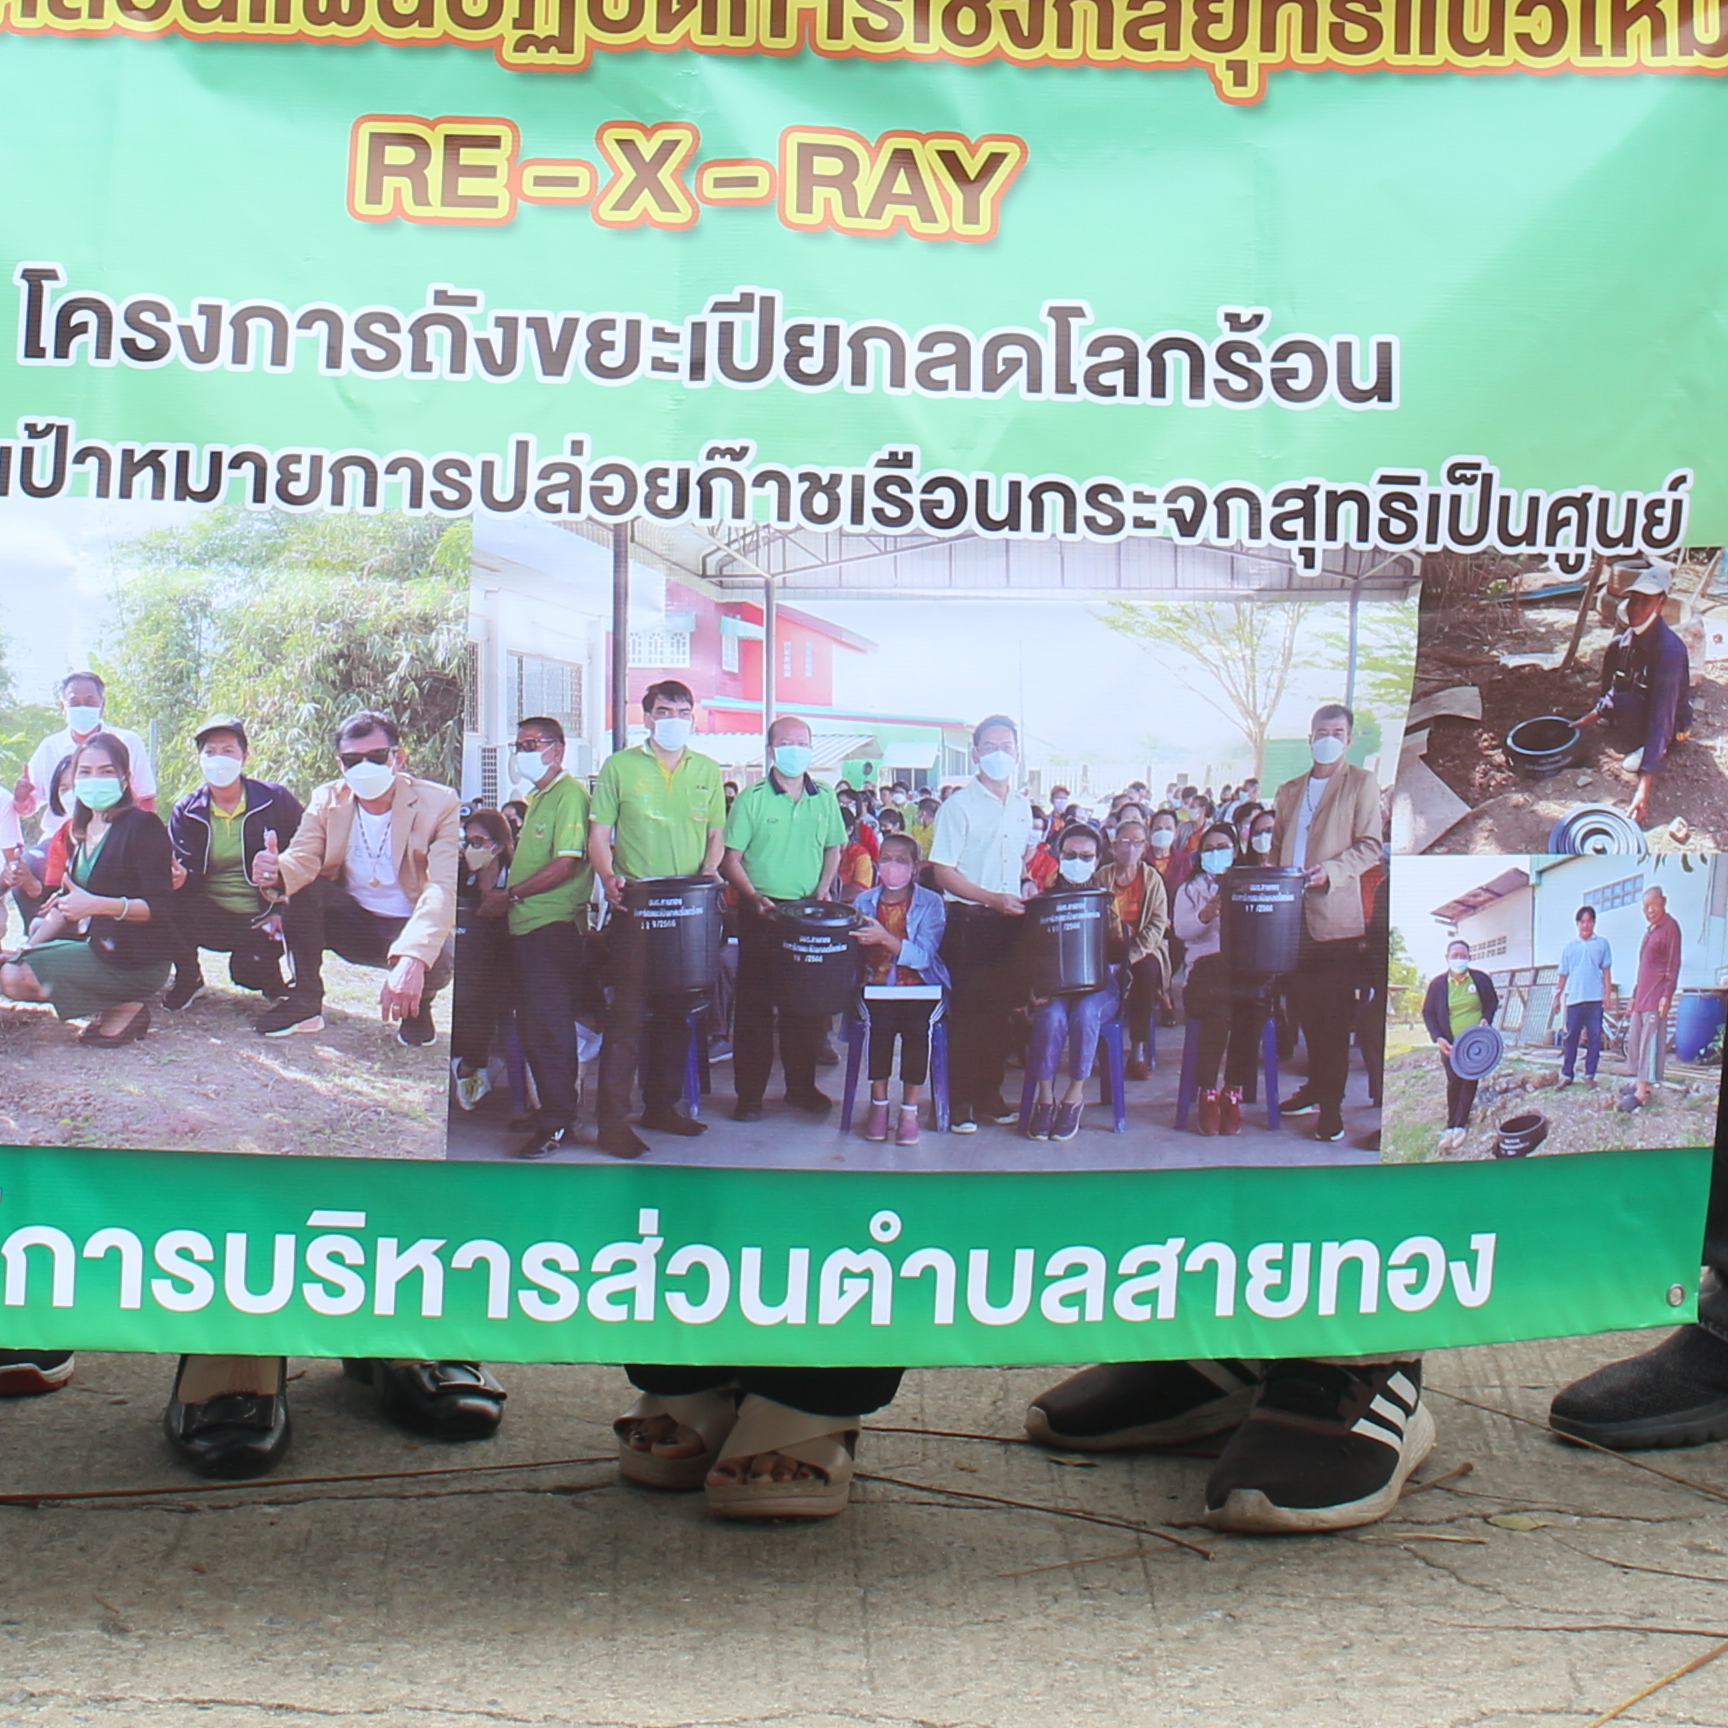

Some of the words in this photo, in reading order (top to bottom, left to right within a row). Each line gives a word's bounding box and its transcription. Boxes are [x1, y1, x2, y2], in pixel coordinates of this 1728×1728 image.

[21, 267, 1394, 406] โครงการถังขยะเปียกลดโลกร้อน
